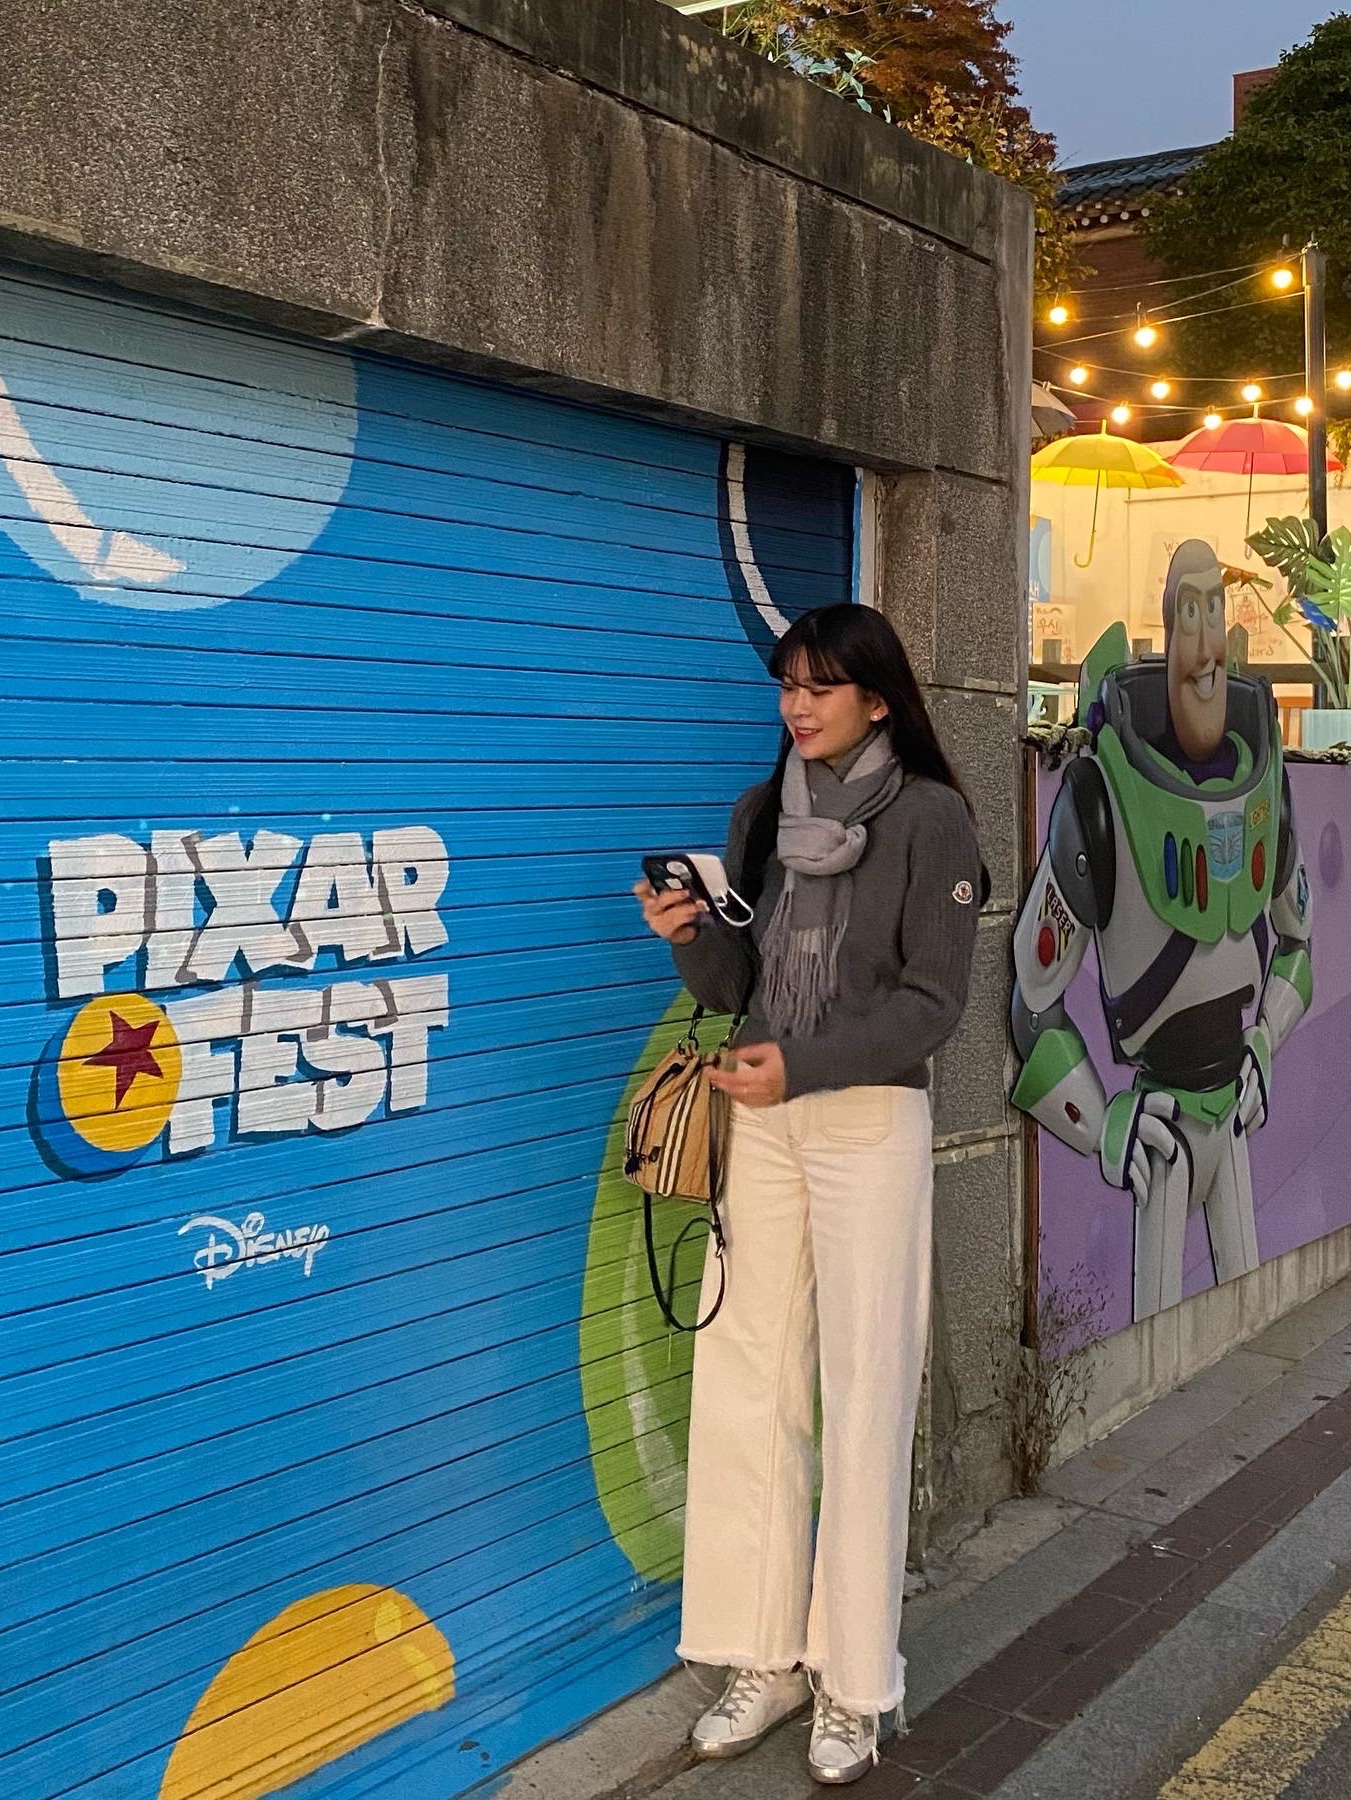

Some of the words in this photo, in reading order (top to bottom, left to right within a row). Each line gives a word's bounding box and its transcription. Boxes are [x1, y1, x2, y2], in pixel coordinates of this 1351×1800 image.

[47, 826, 449, 998] PIXAR
[1047, 888, 1072, 931] LASER
[165, 974, 449, 1154] FEST
